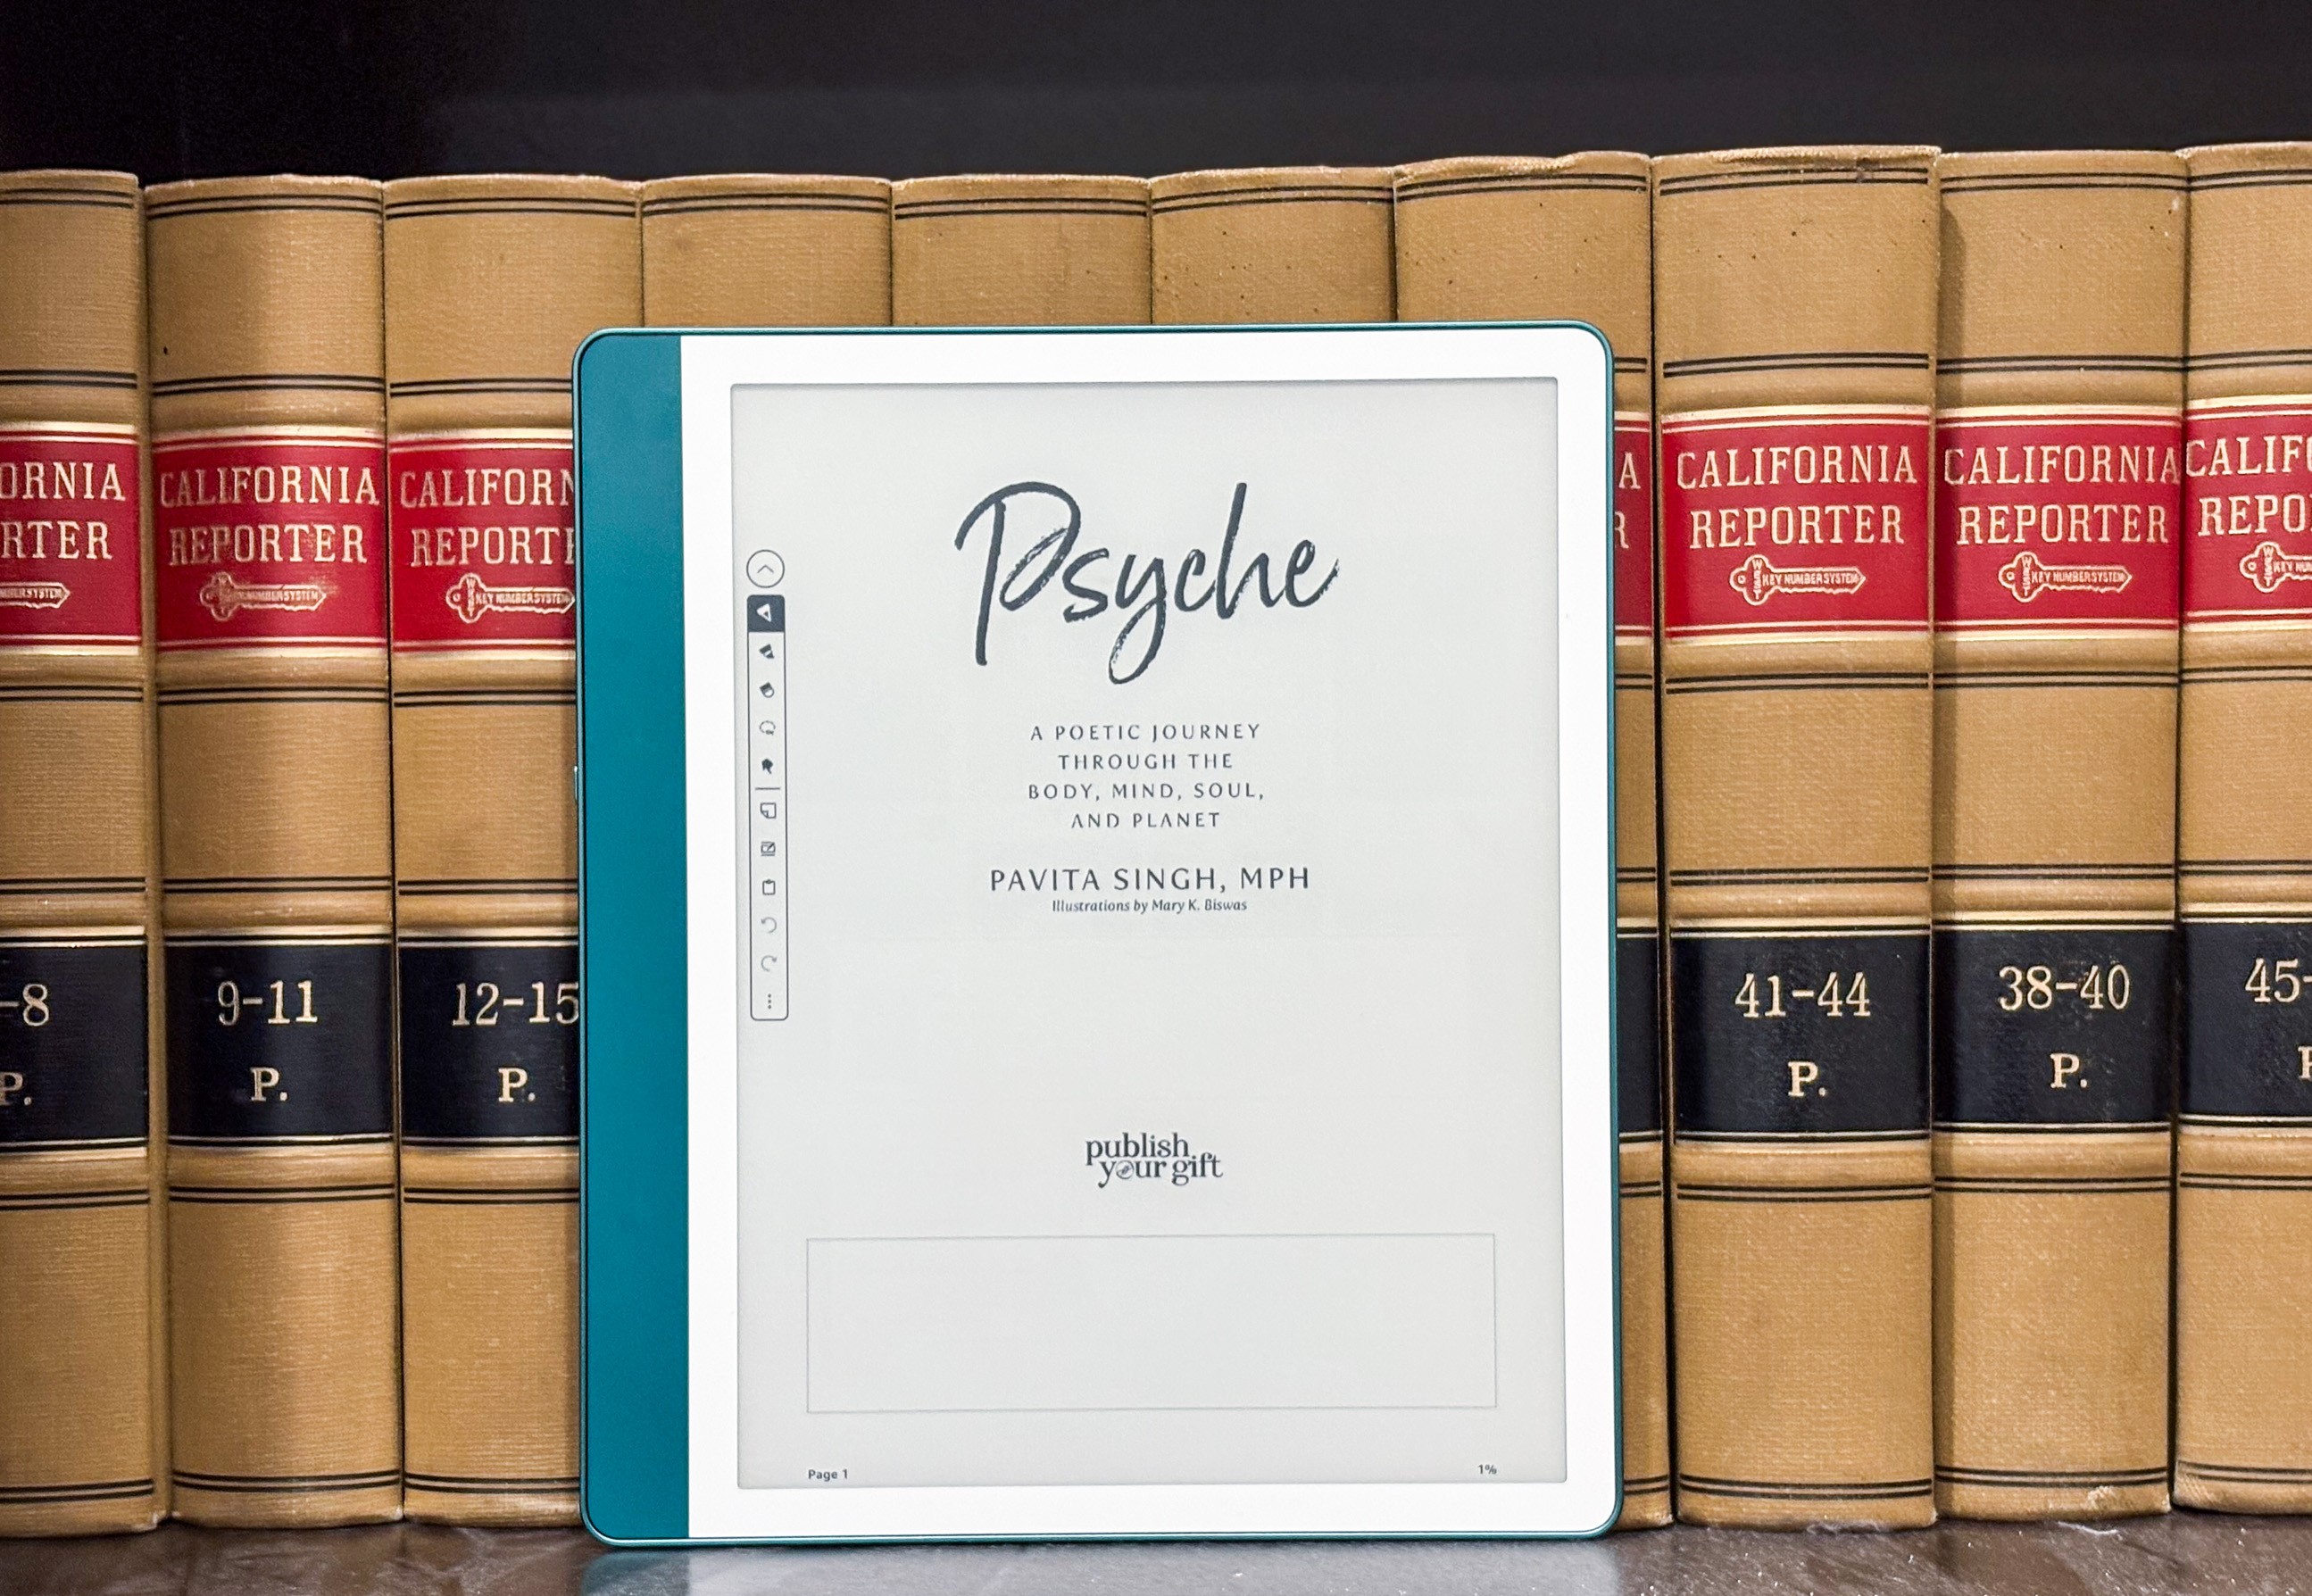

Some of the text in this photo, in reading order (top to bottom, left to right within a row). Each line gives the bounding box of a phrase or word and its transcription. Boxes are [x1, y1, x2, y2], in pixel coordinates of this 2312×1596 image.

[1676, 445, 1917, 490] CALIFORNIA
[1944, 445, 2181, 486] CALIFORNIA
[2186, 435, 2312, 477] CALIF
[161, 465, 380, 508] CALIFORNIA
[1690, 504, 1905, 549] REPORTER
[1957, 504, 2168, 545] REPORTER
[2198, 494, 2312, 536] REPO
[169, 524, 367, 566] REPORTER
[954, 481, 1340, 685] Psyche
[1762, 574, 1783, 586] KEY
[2031, 571, 2051, 584] KEY
[1030, 723, 1260, 743] A POETIC JOURNEY
[1058, 753, 1234, 770] THROUGH THE
[1028, 783, 1265, 802] BODY, MIND, SOUL,
[1071, 812, 1221, 828] AND PLANET
[990, 867, 1310, 894] PAVITA SINGH, MPH
[1052, 898, 1248, 915] Illustrations by Mary K. Biswas
[218, 980, 319, 1027] 9-11
[452, 981, 579, 1027] 12-15
[1734, 971, 1871, 1018] 41-44
[1998, 963, 2130, 1010] 38-40
[250, 1066, 288, 1101] P.
[498, 1067, 536, 1102] P.
[1787, 1060, 1827, 1097] P.
[2050, 1052, 2088, 1088] P.
[1085, 1132, 1190, 1166] publish
[1098, 1151, 1224, 1189] your gift
[808, 1468, 848, 1483] Page 1
[1477, 1464, 1498, 1475] 1%
